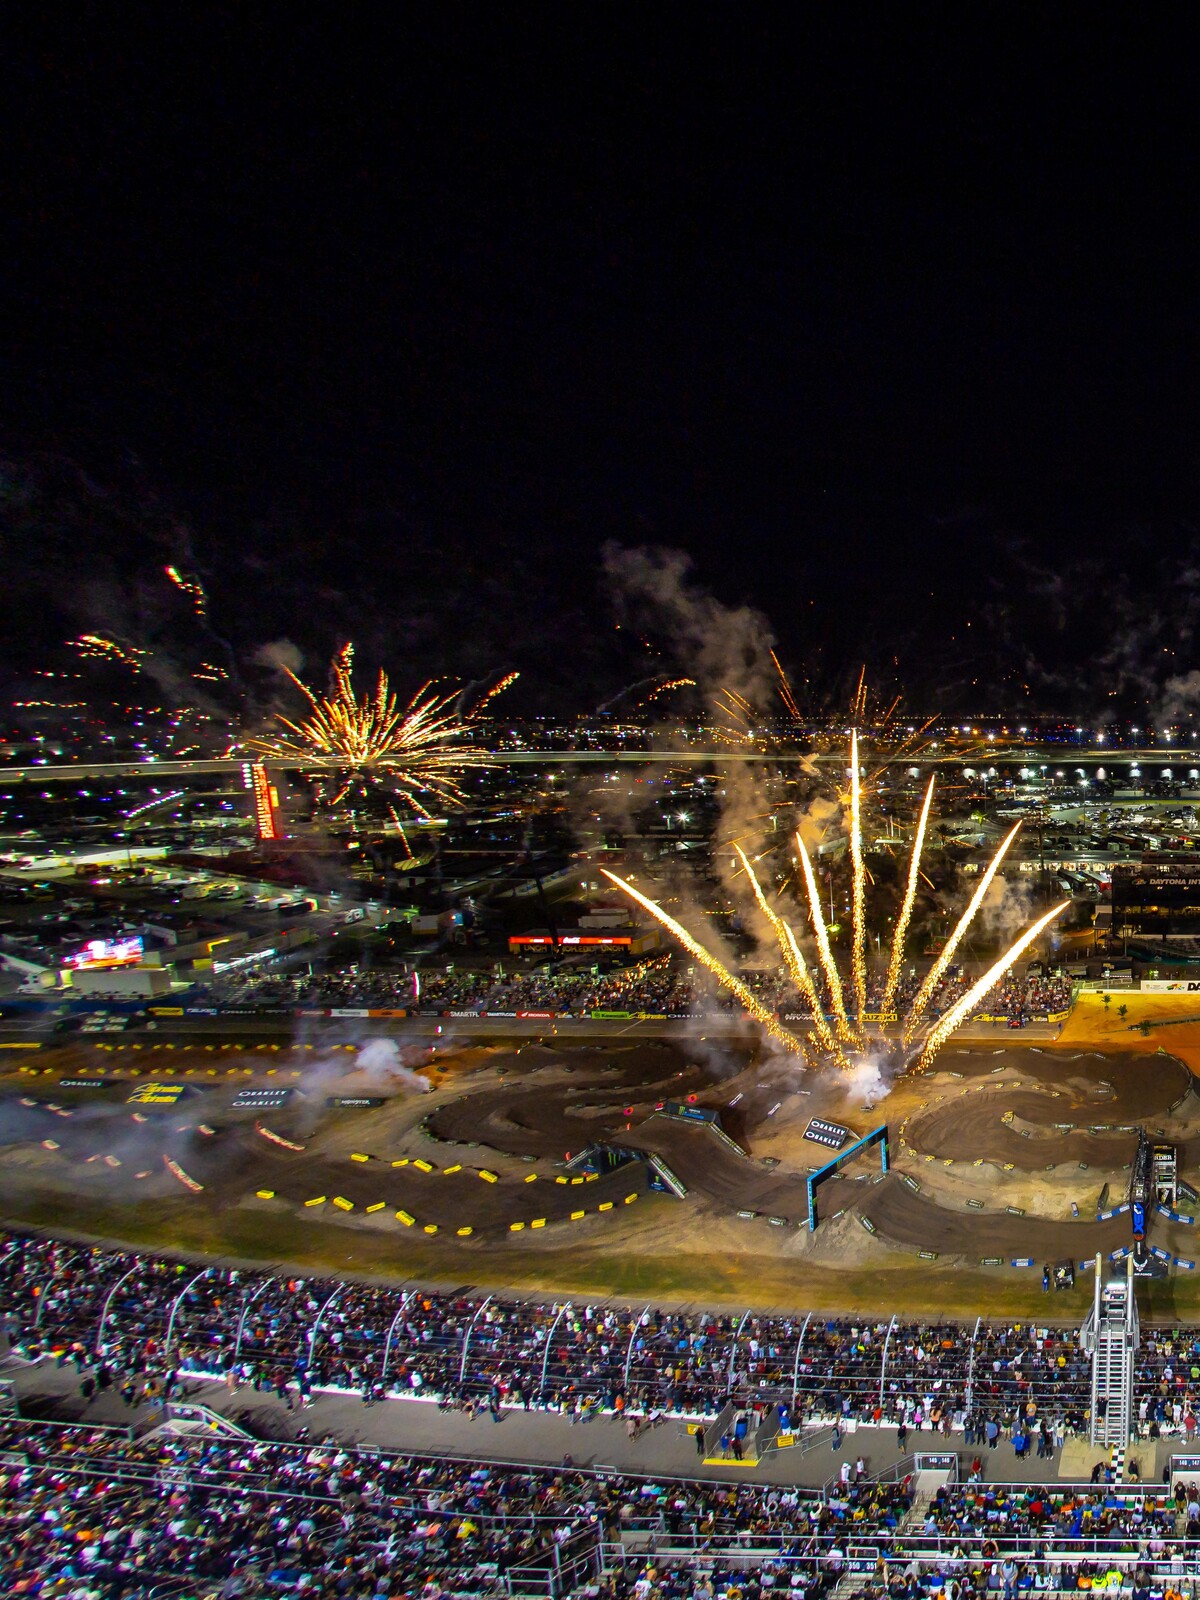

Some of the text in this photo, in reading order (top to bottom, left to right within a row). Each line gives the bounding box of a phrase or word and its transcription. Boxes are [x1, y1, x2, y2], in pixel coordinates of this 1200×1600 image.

[819, 1121, 846, 1136] OAKLEY
[814, 1134, 841, 1148] OAKLEY
[866, 1561, 877, 1570] 351
